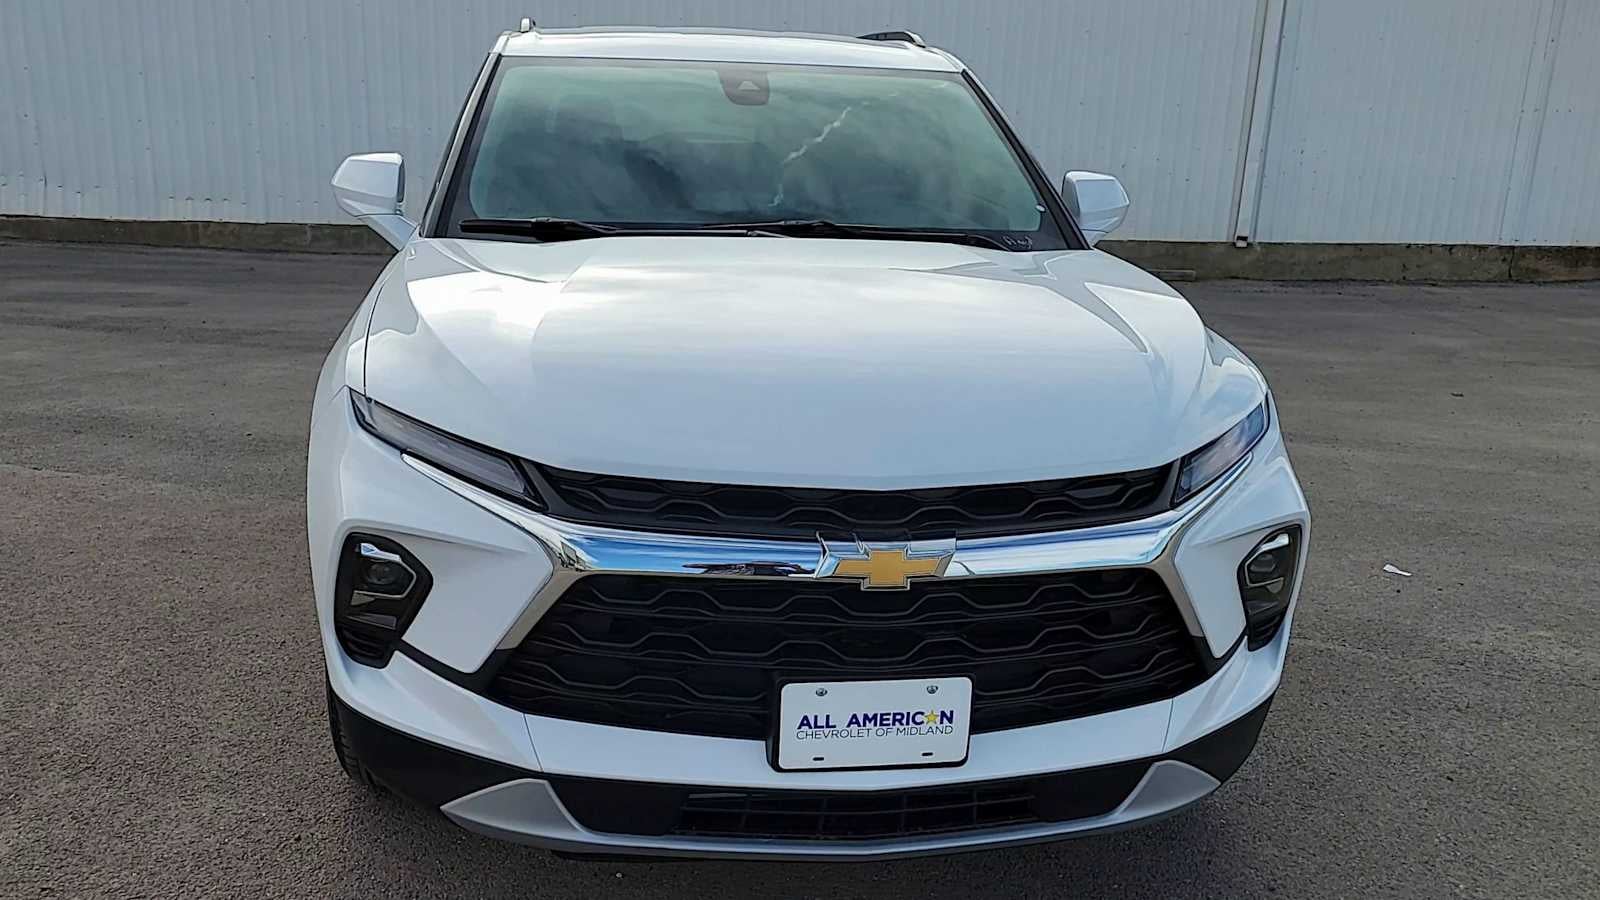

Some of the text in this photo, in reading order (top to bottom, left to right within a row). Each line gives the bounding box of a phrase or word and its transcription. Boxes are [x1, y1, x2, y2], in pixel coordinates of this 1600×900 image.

[797, 715, 837, 729] ALL
[796, 725, 953, 740] CHEVROLET OF MIDLAND
